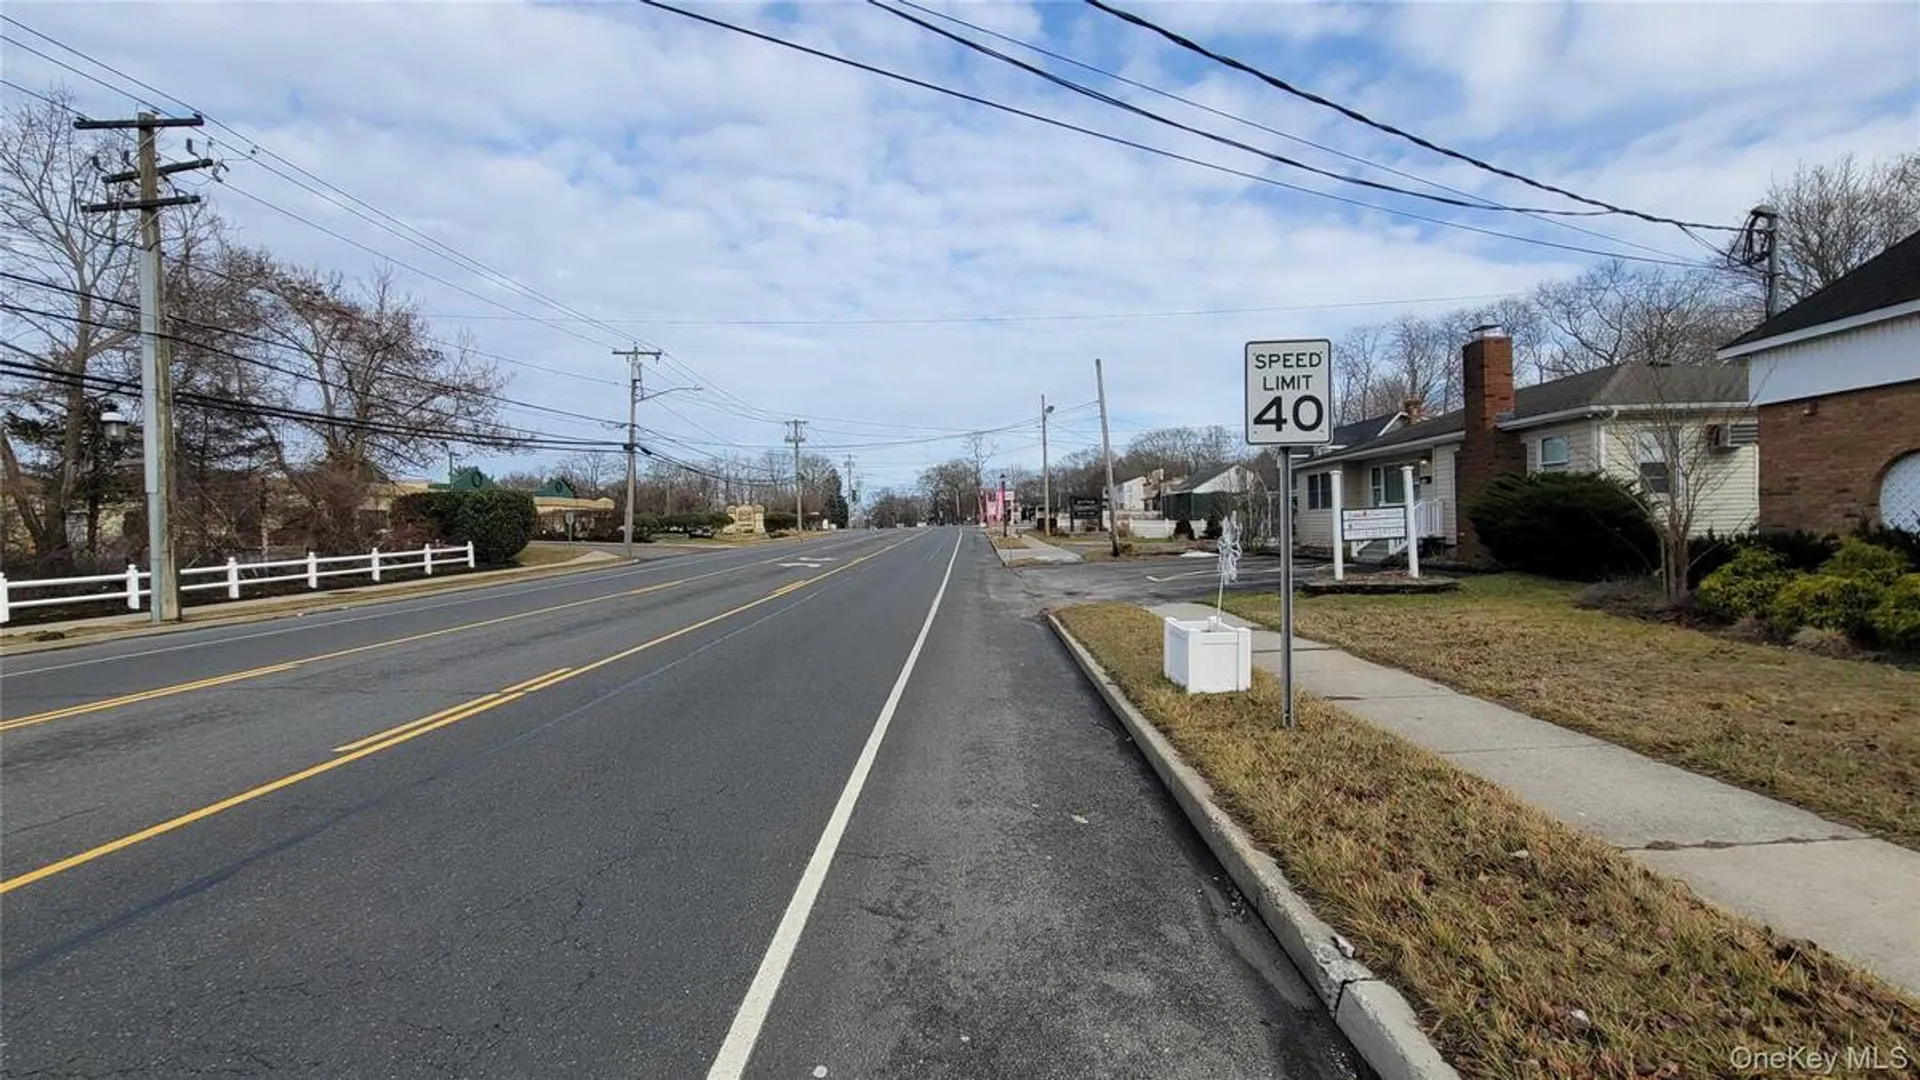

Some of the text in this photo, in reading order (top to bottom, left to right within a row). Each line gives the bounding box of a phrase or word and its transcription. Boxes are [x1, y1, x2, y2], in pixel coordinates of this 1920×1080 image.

[1254, 352, 1322, 370] SPEED
[1263, 375, 1313, 391] LIMIT
[1253, 395, 1324, 432] 40
